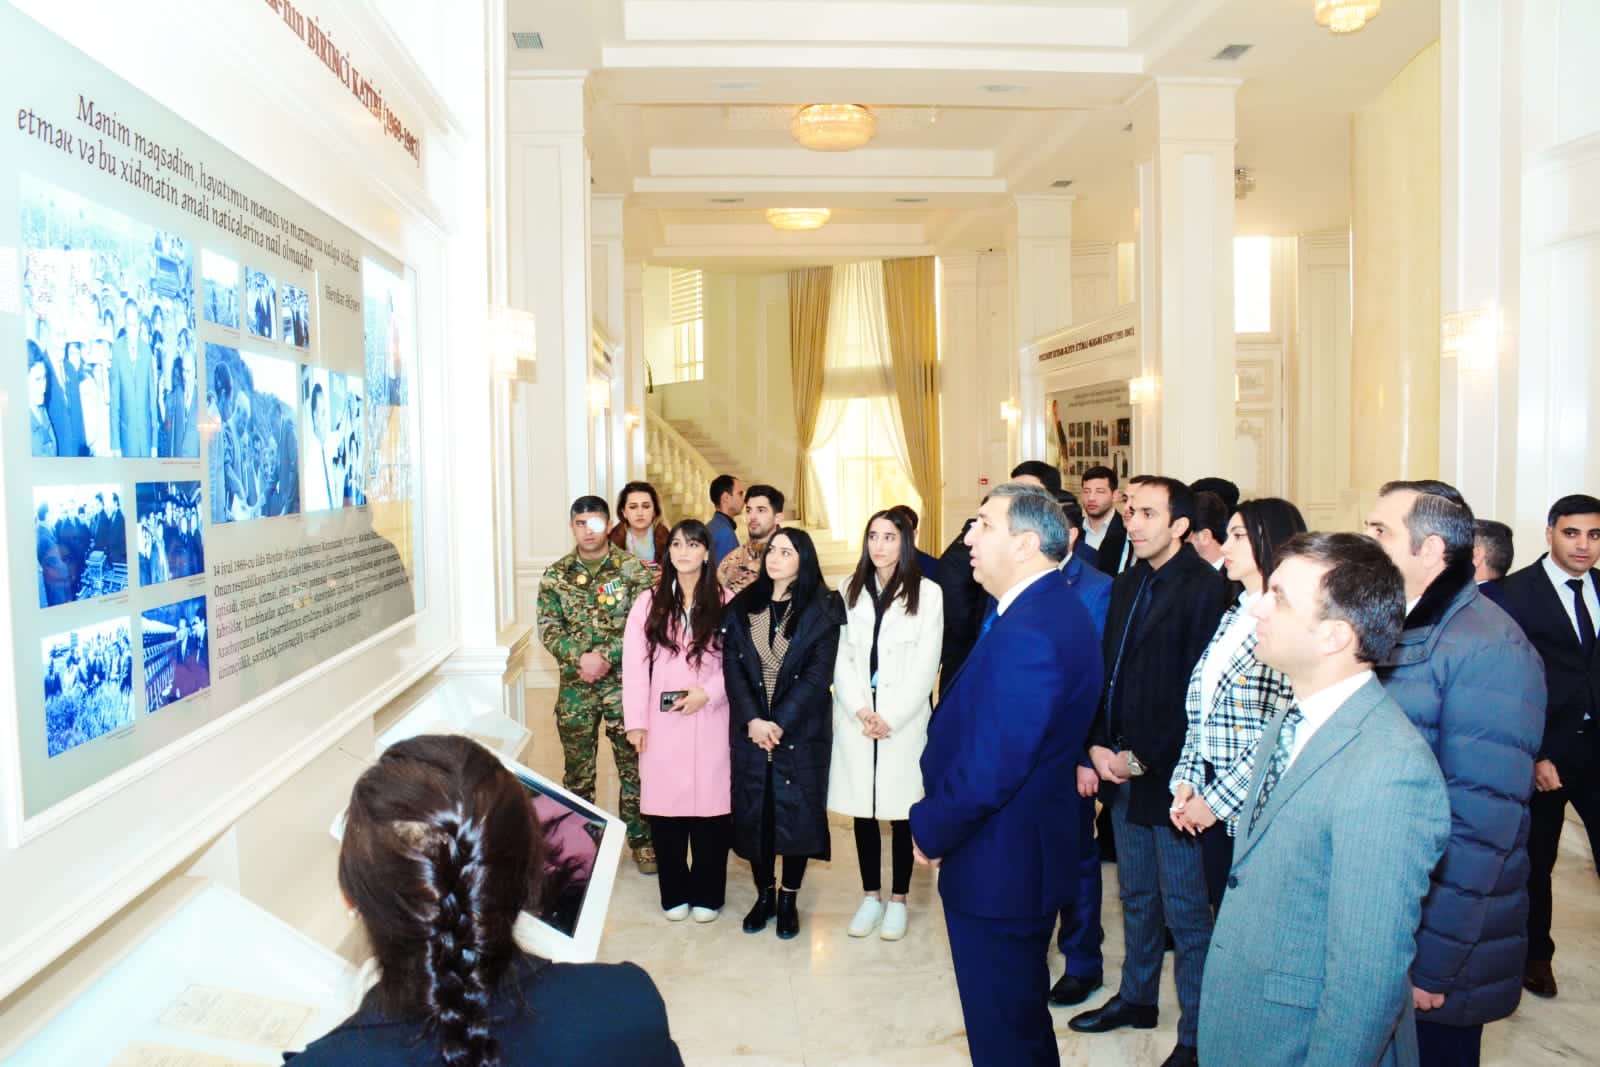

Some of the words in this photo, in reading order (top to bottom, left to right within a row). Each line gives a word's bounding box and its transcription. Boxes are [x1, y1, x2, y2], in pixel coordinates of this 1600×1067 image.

[266, 0, 304, 41] -nın
[307, 15, 350, 89] BİRİNCİ
[17, 108, 74, 155] etmək
[78, 138, 95, 165] və
[98, 140, 117, 176] bu
[120, 158, 179, 206] xidmətin
[76, 94, 131, 147] Mənim
